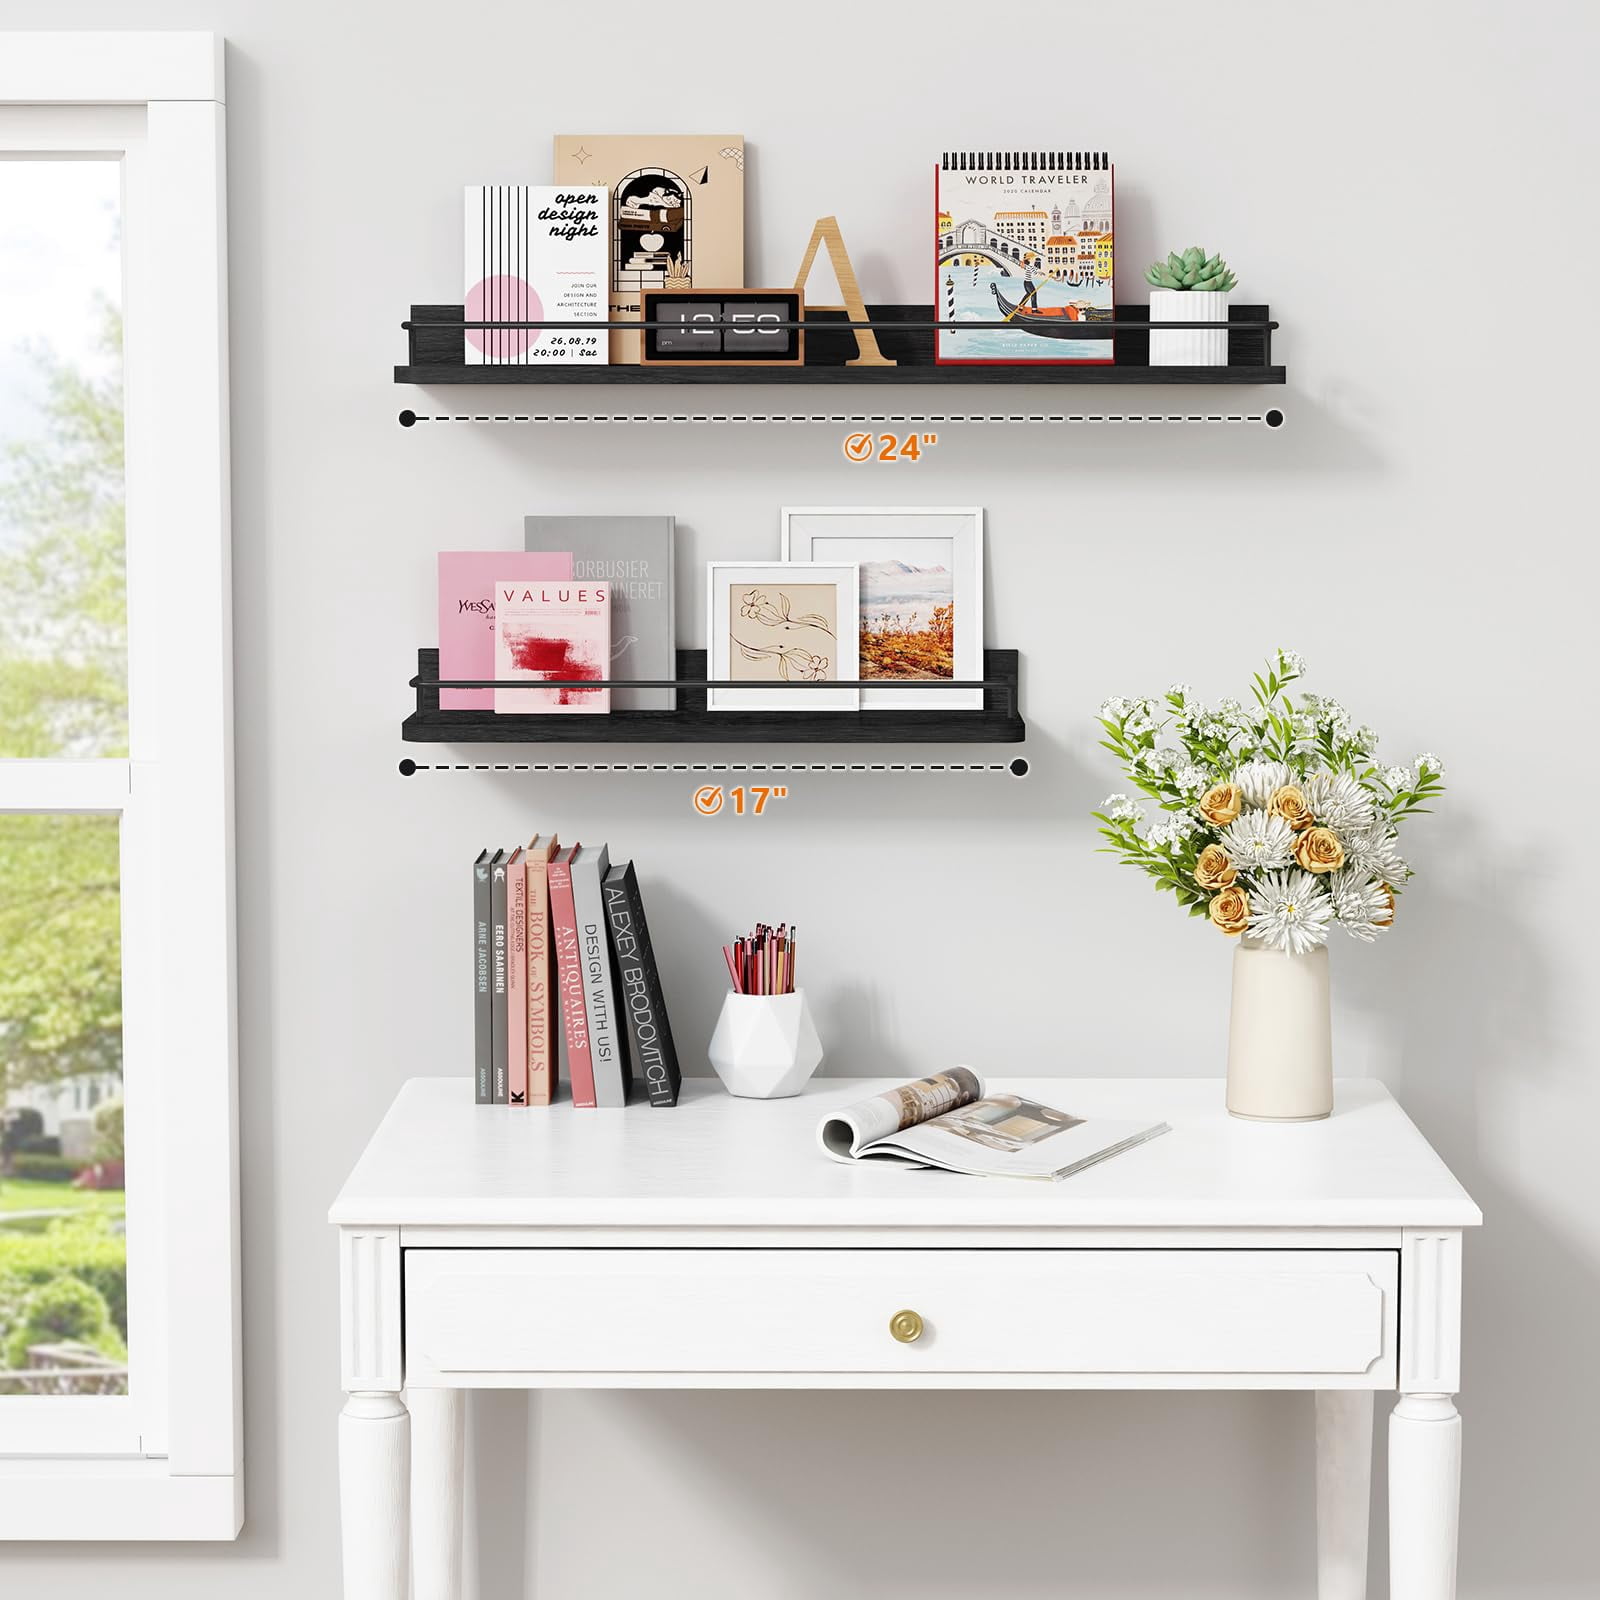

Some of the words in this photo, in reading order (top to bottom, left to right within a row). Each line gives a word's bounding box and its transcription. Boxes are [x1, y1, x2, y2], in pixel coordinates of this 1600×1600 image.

[965, 175, 1014, 185] WORLD
[1021, 174, 1088, 184] TRAVELER
[555, 193, 599, 208] open
[538, 207, 599, 225] design
[549, 223, 599, 241] night
[533, 348, 566, 357] 20:00
[579, 348, 598, 357] Sat
[550, 337, 597, 345] 26.08.19
[572, 560, 649, 578] ORBUSIER
[503, 589, 605, 602] VALUES
[515, 877, 524, 908] TEXTILE
[478, 921, 488, 945] ARNE
[495, 924, 505, 947] EERO
[515, 909, 524, 953] DESIGNERS
[530, 912, 544, 961] BOOK
[585, 924, 603, 984] DESIGN
[478, 947, 488, 993] JACOBSEN
[495, 949, 505, 994] SAARINEN
[562, 926, 588, 1050] ANTIQUAIRES
[605, 887, 639, 962] ALEXEY
[623, 967, 670, 1096] BRODOVITCH
[592, 989, 609, 1031] WITH
[530, 982, 545, 1072] SYMBOLS
[597, 1036, 612, 1063] US!
